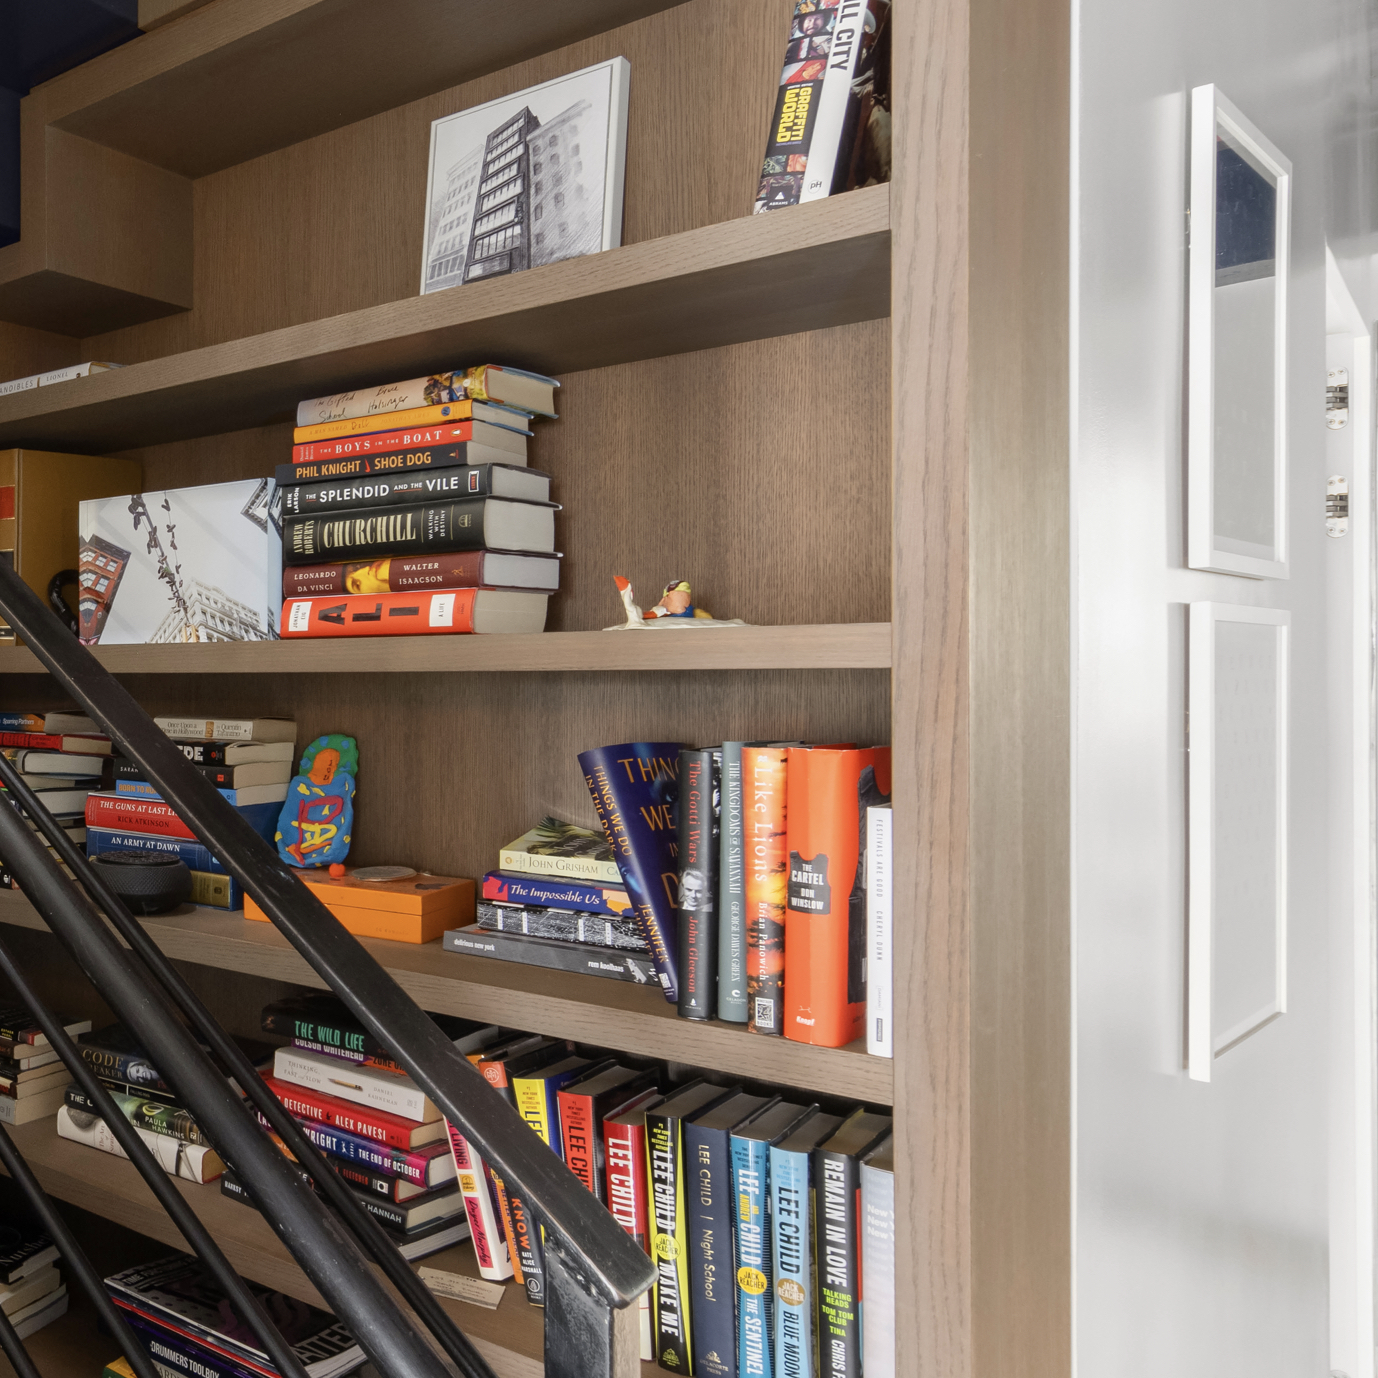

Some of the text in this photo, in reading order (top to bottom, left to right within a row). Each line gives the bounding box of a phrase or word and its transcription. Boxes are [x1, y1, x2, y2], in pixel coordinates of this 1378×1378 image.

[830, 28, 855, 71] CITY
[776, 88, 800, 143] WORLD
[790, 86, 812, 141] GRAFFITI
[296, 460, 361, 479] PHIL KNIGHT
[374, 451, 432, 470] SHOE DOG
[319, 484, 390, 503] SPLENDID
[394, 483, 408, 491] AND
[410, 481, 423, 489] THE
[425, 476, 459, 492] VILE
[323, 513, 417, 548] CHURCHILL
[294, 571, 337, 581] LEONARDO
[403, 562, 440, 571] WALTER
[297, 584, 333, 593] DA VINCI
[399, 575, 443, 586] ISAACSON
[118, 783, 136, 792] BORN
[137, 785, 145, 793] TO
[100, 800, 114, 809] THE
[115, 802, 136, 812] GUNS
[137, 804, 148, 812] AT
[148, 806, 166, 815] LAST
[585, 775, 595, 788] IN
[591, 792, 605, 814] THE
[601, 819, 617, 852] DARK
[593, 765, 632, 856] THINGS WE DO
[640, 805, 676, 831] WE
[688, 760, 701, 864] The Gotti Wars
[754, 767, 773, 882] Like Lions
[111, 836, 181, 853] AN ARMY AT DAWN
[528, 856, 553, 870] JOHN
[555, 859, 599, 875] GRISHAM
[802, 863, 813, 872] THE
[876, 819, 884, 898] FESTIVALS ARE GOOD
[791, 870, 824, 886] CARTEL
[511, 885, 601, 905] The Impossible Us
[800, 887, 815, 899] DON
[791, 897, 824, 911] WINSLOW
[638, 904, 669, 963] JENNIFER
[688, 916, 699, 944] John
[758, 902, 769, 981] Brian Panowich
[688, 948, 699, 993] Gleeson
[796, 1015, 815, 1026] Knopf
[295, 1021, 364, 1052] THE WILD LIFE
[82, 1049, 124, 1069] CODE
[70, 1093, 85, 1104] THE
[368, 1093, 398, 1106] KAHNEMAN
[373, 1086, 394, 1097] DANIEL
[284, 1097, 323, 1120] DETECTIVE
[145, 1116, 167, 1129] PAULA
[152, 1125, 185, 1139] HAWKINS
[335, 1114, 386, 1141] ALEX PAVESI
[358, 1148, 420, 1179] THE END OF OCTOBER
[608, 1137, 636, 1228] LEE CHILD
[653, 1150, 675, 1231] LEE CHILD
[738, 1169, 759, 1195] LEE
[778, 1186, 799, 1220] LEE
[367, 1204, 402, 1224] HANNAH
[511, 1197, 531, 1250] KNOW
[698, 1144, 716, 1302] LEE CHILD Night School
[824, 1158, 847, 1288] REMAIN IN LOVE
[740, 1223, 761, 1265] CHILD
[779, 1221, 800, 1274] CHILD
[739, 1277, 765, 1290] REACHER
[743, 1272, 760, 1281] JACK
[781, 1281, 799, 1293] JACK
[659, 1261, 679, 1337] MAKE ME
[777, 1287, 804, 1302] REACHER
[822, 1287, 852, 1302] TALKING
[825, 1297, 849, 1309] HEADS
[746, 1298, 758, 1314] THE
[822, 1305, 854, 1321] TOM TOM
[783, 1310, 799, 1341] BLUE
[828, 1315, 848, 1327] CLUB
[829, 1325, 846, 1337] TINA
[150, 1340, 189, 1369] DRUMMERS
[745, 1315, 764, 1375] SENTINEL
[831, 1339, 846, 1371] CHRIS
